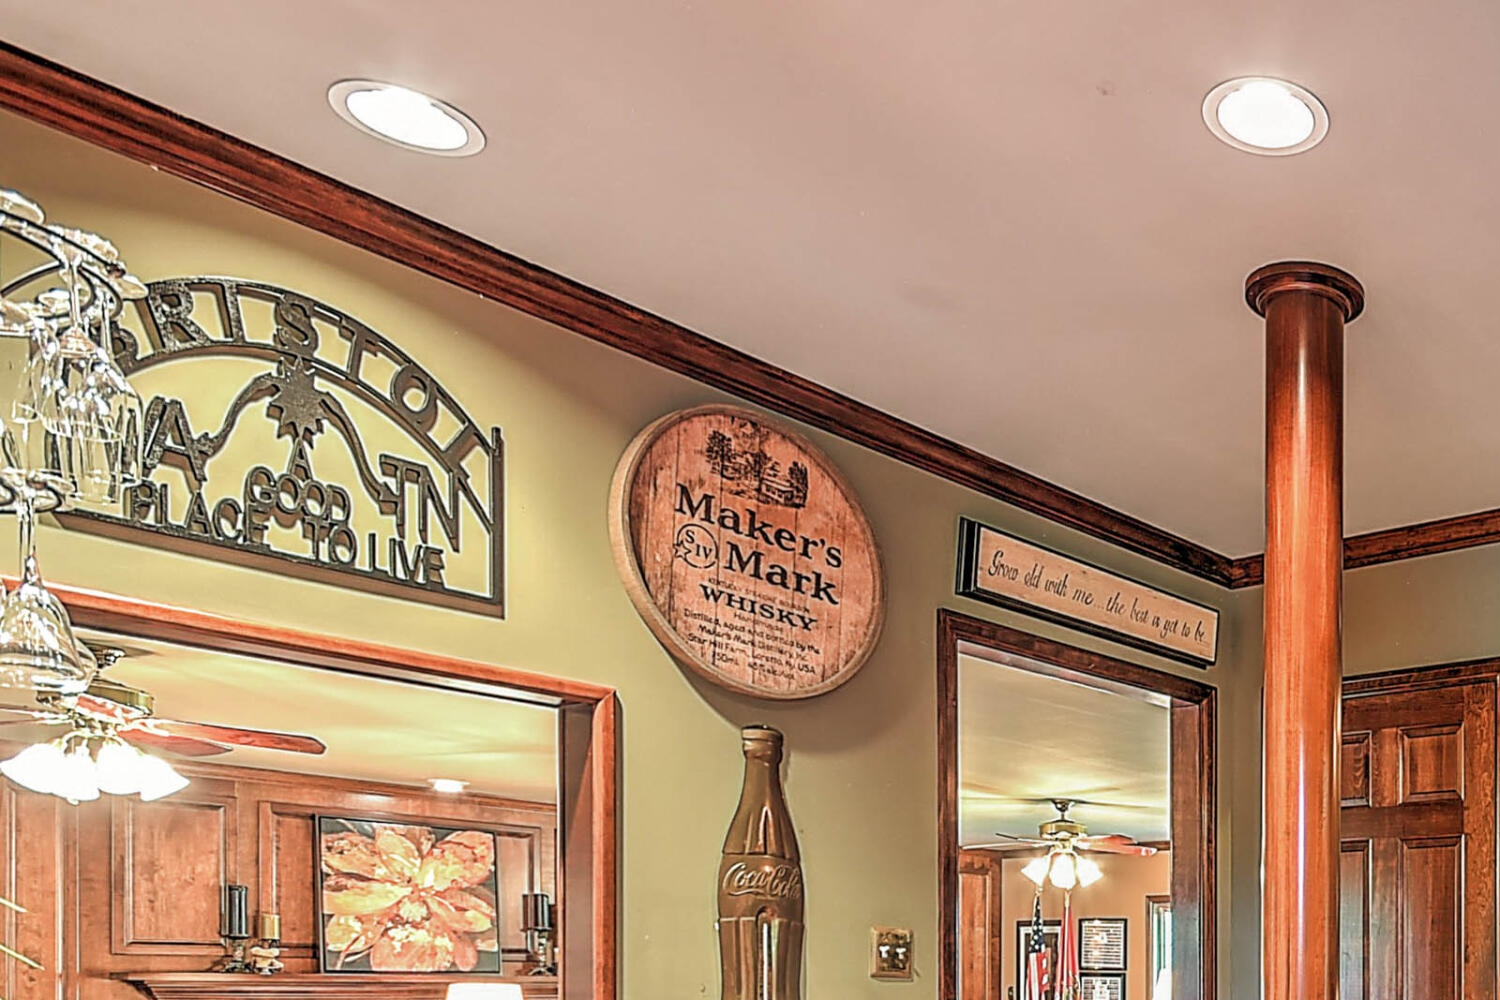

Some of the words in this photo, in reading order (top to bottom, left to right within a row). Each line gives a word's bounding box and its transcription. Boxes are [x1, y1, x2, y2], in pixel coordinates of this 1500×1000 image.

[286, 436, 314, 484] A
[244, 465, 352, 523] GOOD
[379, 453, 461, 554] TN
[128, 481, 270, 548] PLACE
[302, 516, 357, 565] TO
[368, 532, 446, 588] LIVE
[674, 482, 843, 569] Maker's
[685, 529, 696, 544] S
[695, 544, 713, 560] IV
[723, 540, 840, 606] Mark
[988, 550, 1019, 581] Grow
[1023, 563, 1044, 589] old
[1044, 573, 1069, 598] with
[1106, 591, 1127, 615] the
[1180, 621, 1191, 638] to
[699, 583, 819, 632] WHISKY
[796, 639, 807, 653] by
[797, 663, 817, 675] USA
